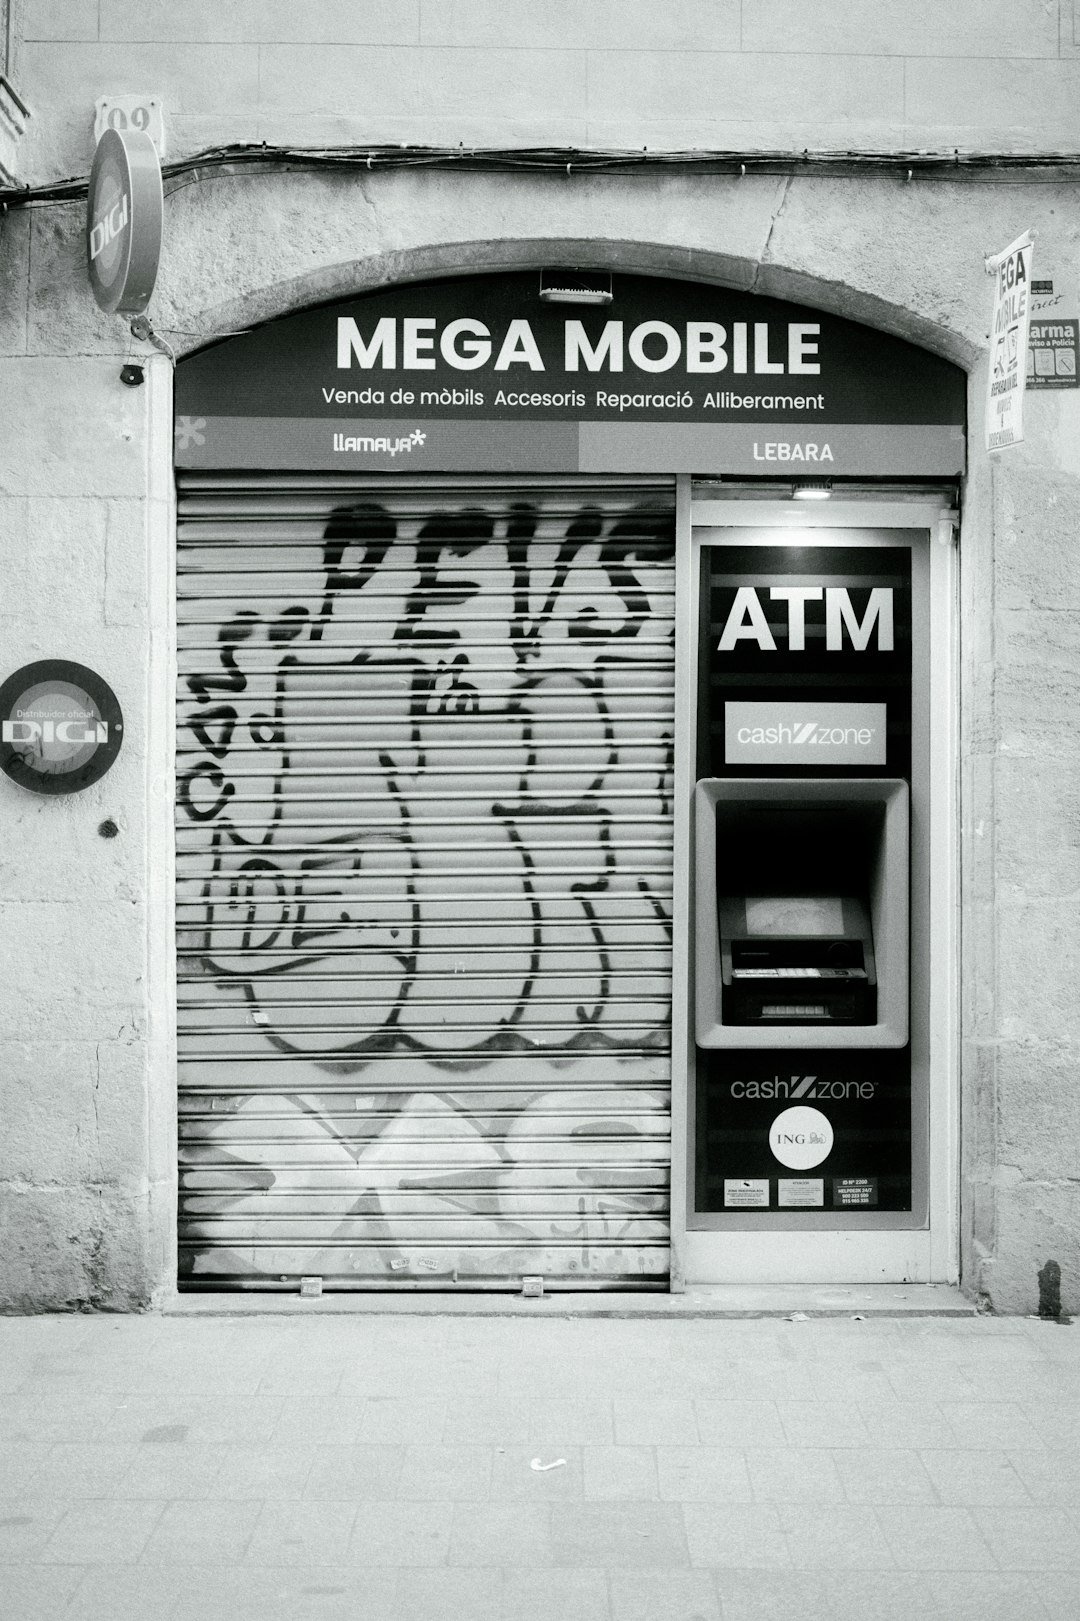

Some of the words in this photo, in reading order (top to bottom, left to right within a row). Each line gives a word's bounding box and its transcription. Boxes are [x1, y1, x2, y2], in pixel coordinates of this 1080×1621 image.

[90, 193, 128, 260] DIGI
[337, 316, 546, 371] MEGA
[564, 319, 821, 375] MOBILE
[322, 388, 385, 405] Venda
[390, 388, 415, 405] de
[420, 388, 484, 406] mòbils
[494, 390, 586, 407] Accesoris
[596, 390, 693, 411] Reparació
[703, 391, 825, 410] Alliberament
[753, 442, 834, 462] LEBARA
[717, 586, 894, 651] ATM
[2, 720, 108, 744] DIGI
[777, 1134, 805, 1145] ING
